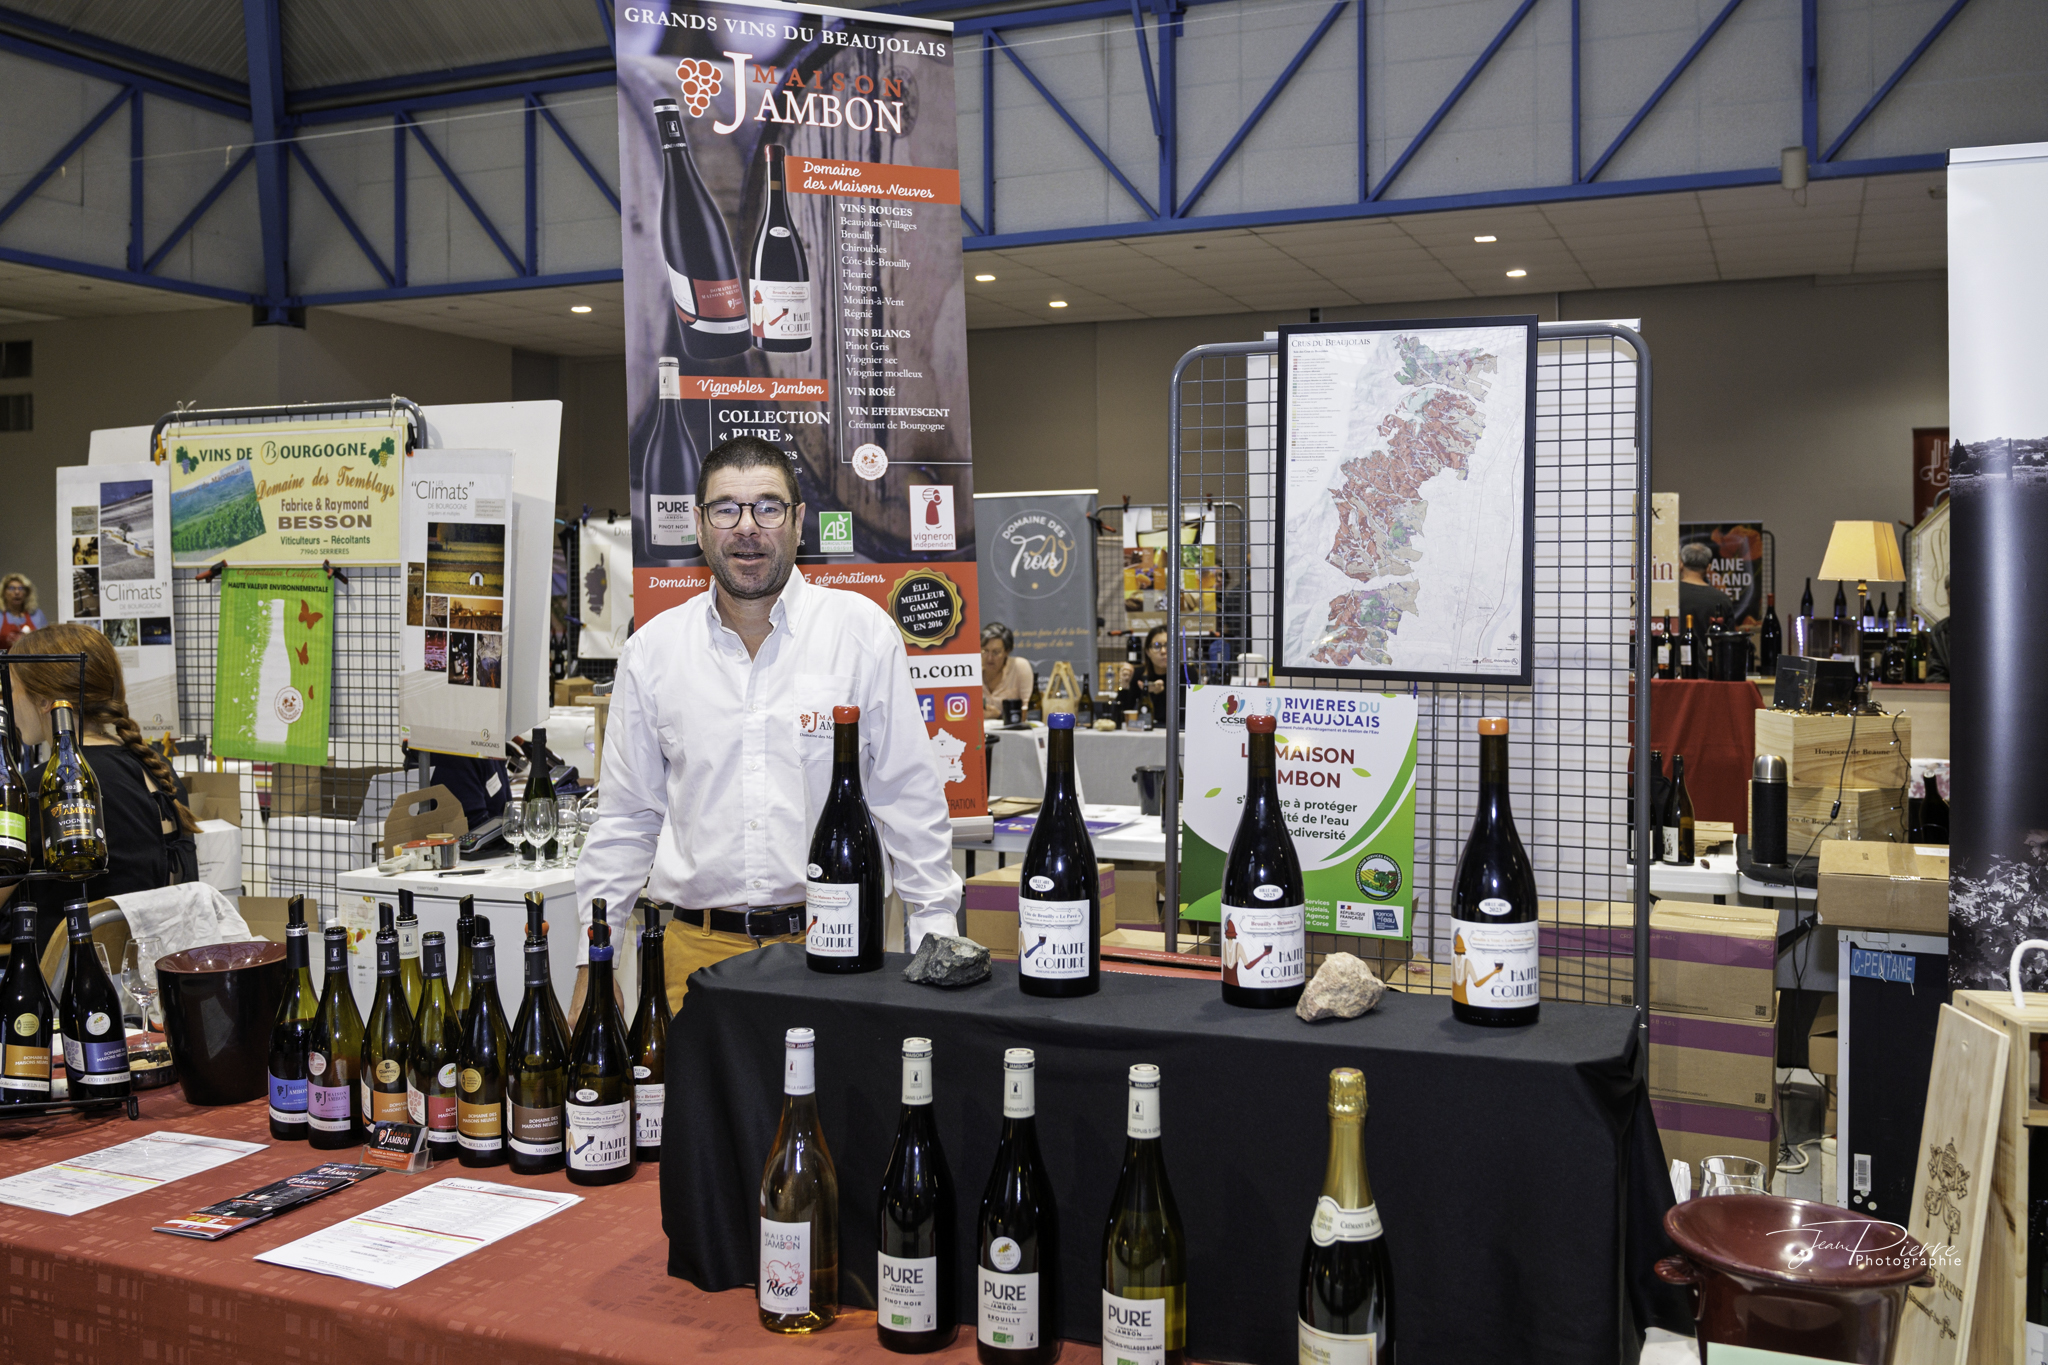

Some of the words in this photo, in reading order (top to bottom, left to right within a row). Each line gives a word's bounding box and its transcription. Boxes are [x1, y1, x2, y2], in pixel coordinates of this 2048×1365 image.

[624, 7, 717, 31] GRANDS
[724, 18, 776, 38] VINS
[783, 25, 814, 42] DU
[821, 29, 946, 57] BEAUJOLAIS
[752, 64, 903, 97] MAISON
[713, 51, 904, 135] JAMBON
[803, 161, 862, 177] Domaine
[803, 177, 827, 190] des
[829, 180, 884, 195] Maisons
[886, 184, 935, 198] Neuves
[839, 203, 866, 214] VINS
[868, 205, 913, 217] ROUGES
[840, 216, 917, 233] Beaujolais-Villages
[841, 229, 874, 242] Brouilly
[841, 242, 887, 254] Chiroubles
[842, 255, 911, 271] Côte-de-Brouilly
[843, 269, 872, 279] Fleurie
[843, 282, 878, 294] Morgon
[844, 295, 905, 306] Moulin-à-Vent
[844, 308, 873, 320] Régnié
[844, 328, 869, 338] VINS
[871, 328, 911, 339] BLANCS
[845, 341, 868, 351] Pinot
[870, 341, 890, 351] Gris
[1291, 339, 1311, 348] CRUS
[1325, 338, 1371, 347] BEAUJOLAIS
[846, 354, 883, 366] Viognier
[884, 357, 898, 365] sec
[846, 367, 883, 379] Viognier
[885, 369, 923, 379] moelleux
[696, 379, 766, 398] Vignobles
[769, 381, 825, 399] Jambon
[847, 387, 866, 396] VIN
[868, 385, 896, 397] ROSÉ
[718, 410, 831, 425] COLLECTION
[847, 406, 869, 416] VIN
[871, 406, 950, 417] EFFERVESCENT
[848, 420, 885, 430] Crémant
[887, 420, 898, 430] de
[900, 421, 946, 433] Bourgogne
[731, 428, 781, 441] PURE
[199, 448, 231, 462] VINS
[236, 447, 253, 461] DE
[260, 440, 367, 465] BOURGOGNE
[256, 473, 305, 501] Domaine
[312, 466, 329, 487] des
[336, 465, 395, 503] Tremblays
[281, 498, 313, 512] Fabrice
[315, 499, 323, 511] &
[324, 496, 369, 513] Raymond
[657, 501, 690, 514] PURE
[278, 514, 373, 531] BESSON
[1002, 515, 1047, 540] DOMAINE
[1047, 519, 1067, 539] DES
[823, 520, 848, 541] AB
[913, 532, 954, 542] vigneron
[280, 535, 320, 546] Viticulteurs
[331, 534, 371, 545] Récoltants
[300, 548, 319, 556] 71960
[319, 547, 350, 556] SERRIERES
[1710, 558, 1744, 571] AINE
[648, 575, 707, 589] Domaine
[815, 571, 886, 587] générations
[1706, 573, 1752, 586] RAND
[228, 582, 246, 590] HAUTE
[247, 582, 268, 591] VALEUR
[269, 583, 329, 594] ENVIRONNEMENTALE
[912, 582, 930, 593] ÉLU
[901, 590, 945, 605] MEILLEUR
[132, 602, 162, 610] BOURGOGNE
[909, 601, 939, 612] GAMAY
[902, 614, 916, 624] DU
[917, 608, 950, 621] MONDE
[913, 622, 927, 631] EN
[927, 620, 943, 630] 2016
[1284, 696, 1356, 713] RIVIÈRES
[1359, 701, 1380, 714] DU
[1220, 716, 1247, 724] CCSB
[1282, 711, 1380, 729] BEAUJOLAIS
[471, 740, 500, 749] BOURGOGNES
[1275, 745, 1355, 765] MAISON
[1277, 769, 1341, 789] MBON
[1294, 798, 1301, 809] à
[1304, 799, 1358, 813] protéger
[1302, 813, 1317, 824] de
[1305, 898, 1330, 906] Services
[822, 923, 854, 934] HAUTE
[811, 936, 854, 948] COUTURE
[1052, 942, 1085, 955] HAUTE
[1036, 957, 1085, 969] COUTURE
[1510, 966, 1538, 982] HAUTE
[381, 1127, 411, 1146] JAMBON
[599, 1135, 628, 1151] HAUTE
[535, 1146, 560, 1154] MORGON
[584, 1148, 628, 1163] COUTURE
[1340, 1219, 1364, 1229] CRÉMANT
[764, 1231, 800, 1241] MAISON
[883, 1263, 924, 1284] PURE
[766, 1278, 798, 1297] Rosé
[889, 1286, 915, 1294] JAMBON
[984, 1279, 1027, 1302] PURE
[884, 1297, 902, 1306] PINOT
[990, 1303, 1017, 1312] JAMBON
[987, 1313, 1021, 1323] BROUILLY
[1108, 1304, 1152, 1327] PURE
[1115, 1329, 1142, 1337] JAMBON
